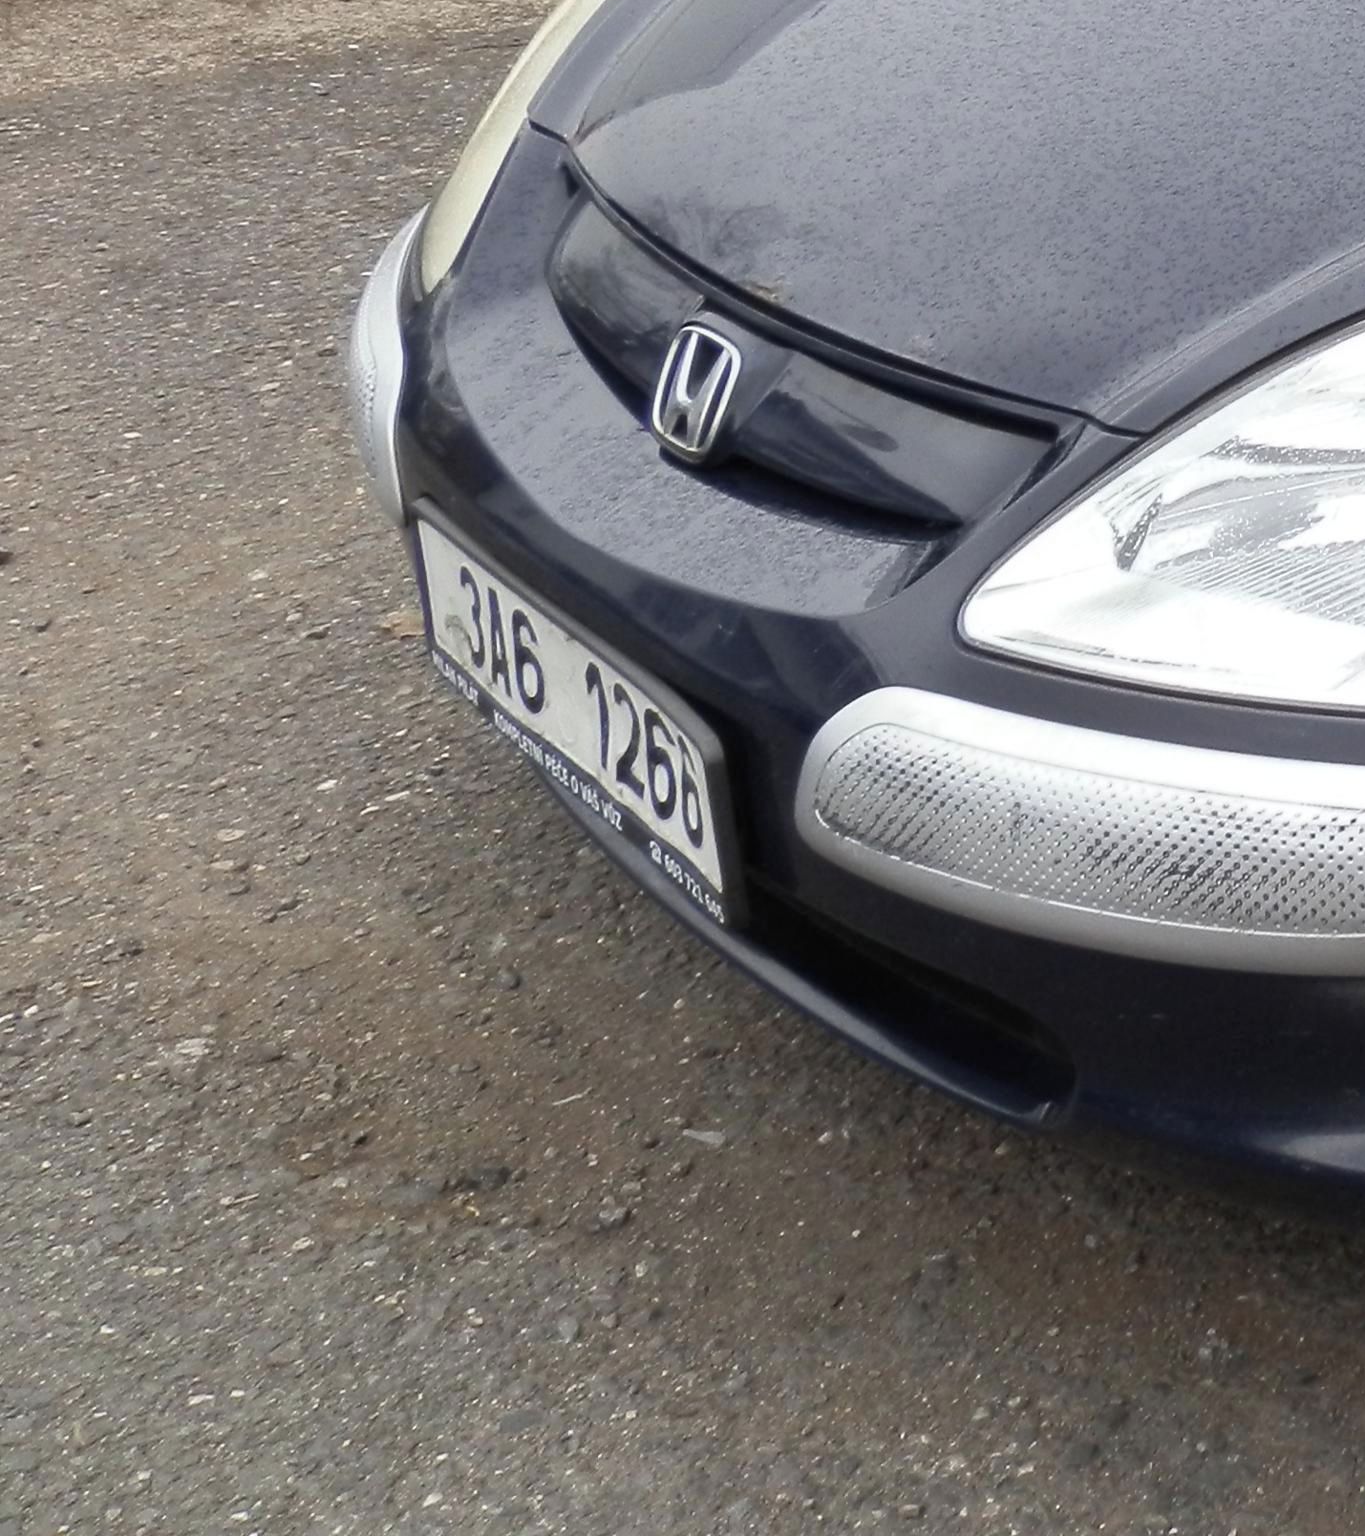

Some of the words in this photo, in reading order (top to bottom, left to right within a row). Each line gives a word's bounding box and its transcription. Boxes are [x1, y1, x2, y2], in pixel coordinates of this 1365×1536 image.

[460, 565, 545, 714] 3A6
[585, 661, 703, 849] 1266
[570, 775, 579, 794] O
